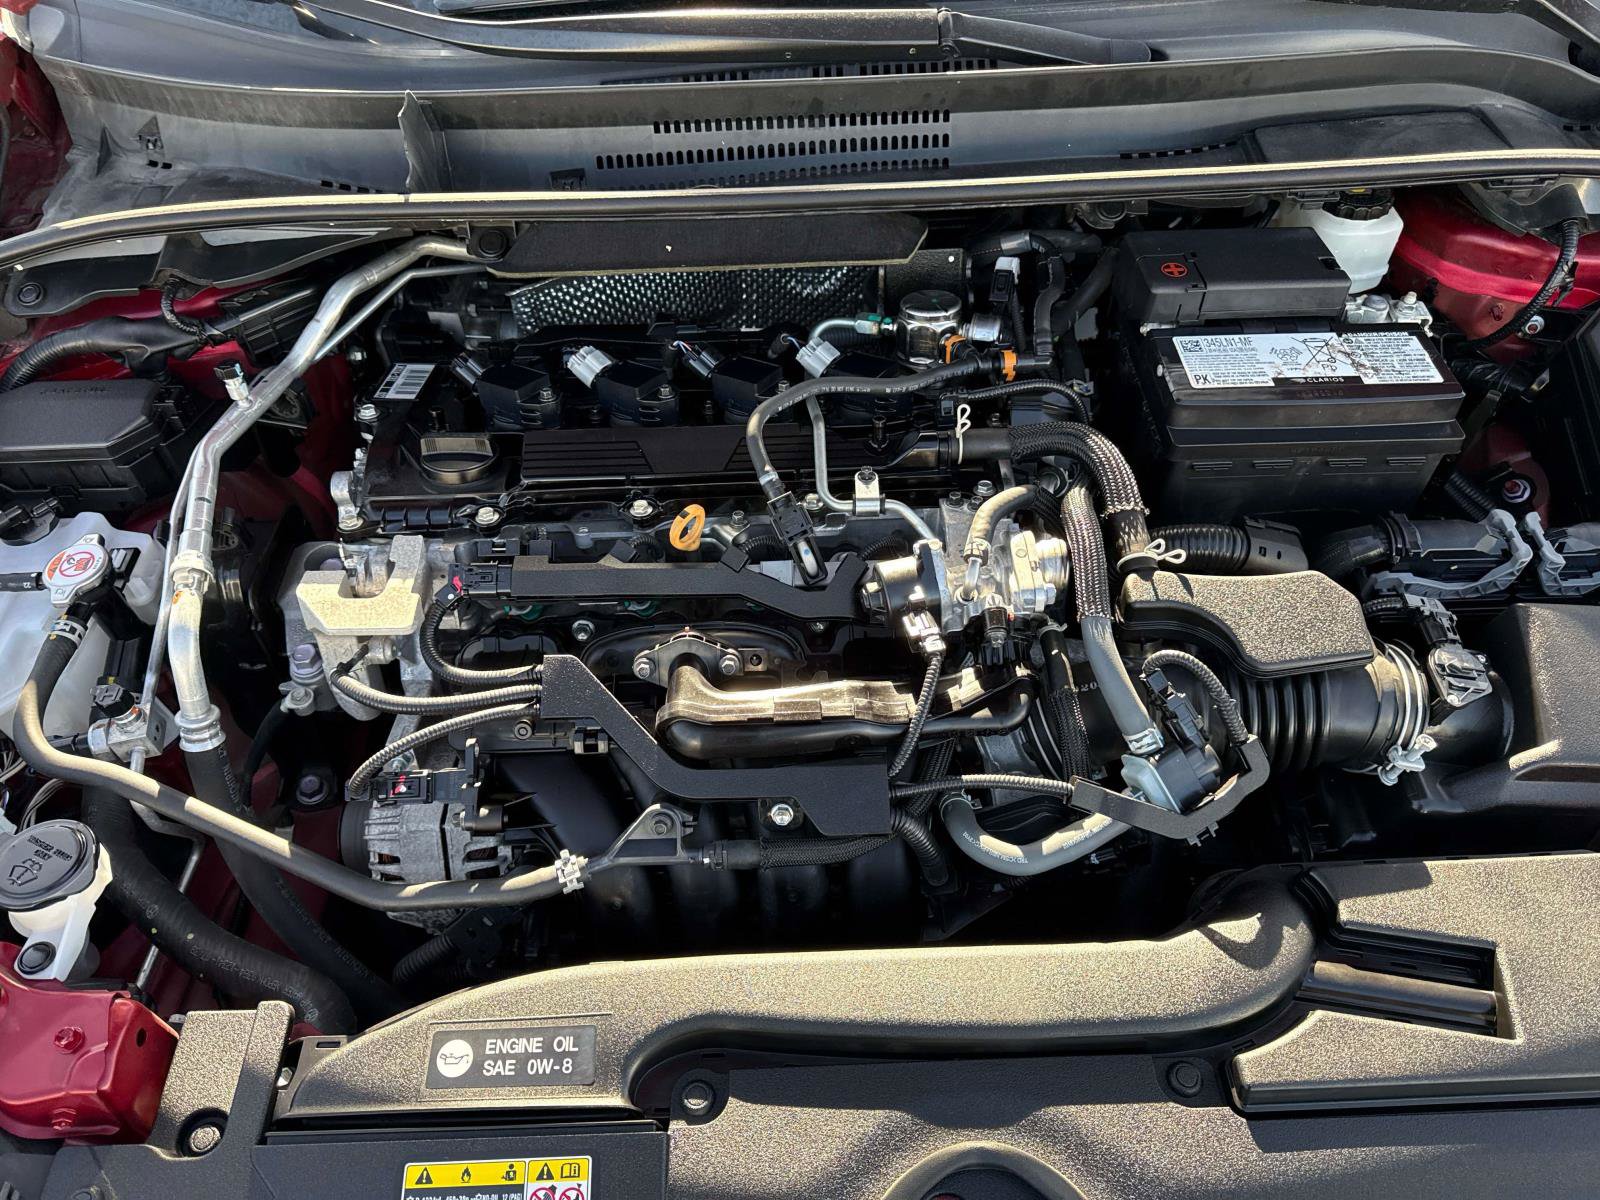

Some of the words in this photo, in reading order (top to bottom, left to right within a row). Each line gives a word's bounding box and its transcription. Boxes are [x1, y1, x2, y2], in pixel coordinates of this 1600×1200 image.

[1203, 336, 1253, 348] 345LN1-MF
[1194, 374, 1212, 385] PK
[485, 1037, 543, 1055] ENGINE
[553, 1036, 579, 1052] OIL
[482, 1060, 516, 1076] SAE
[527, 1058, 573, 1075] 0W-8
